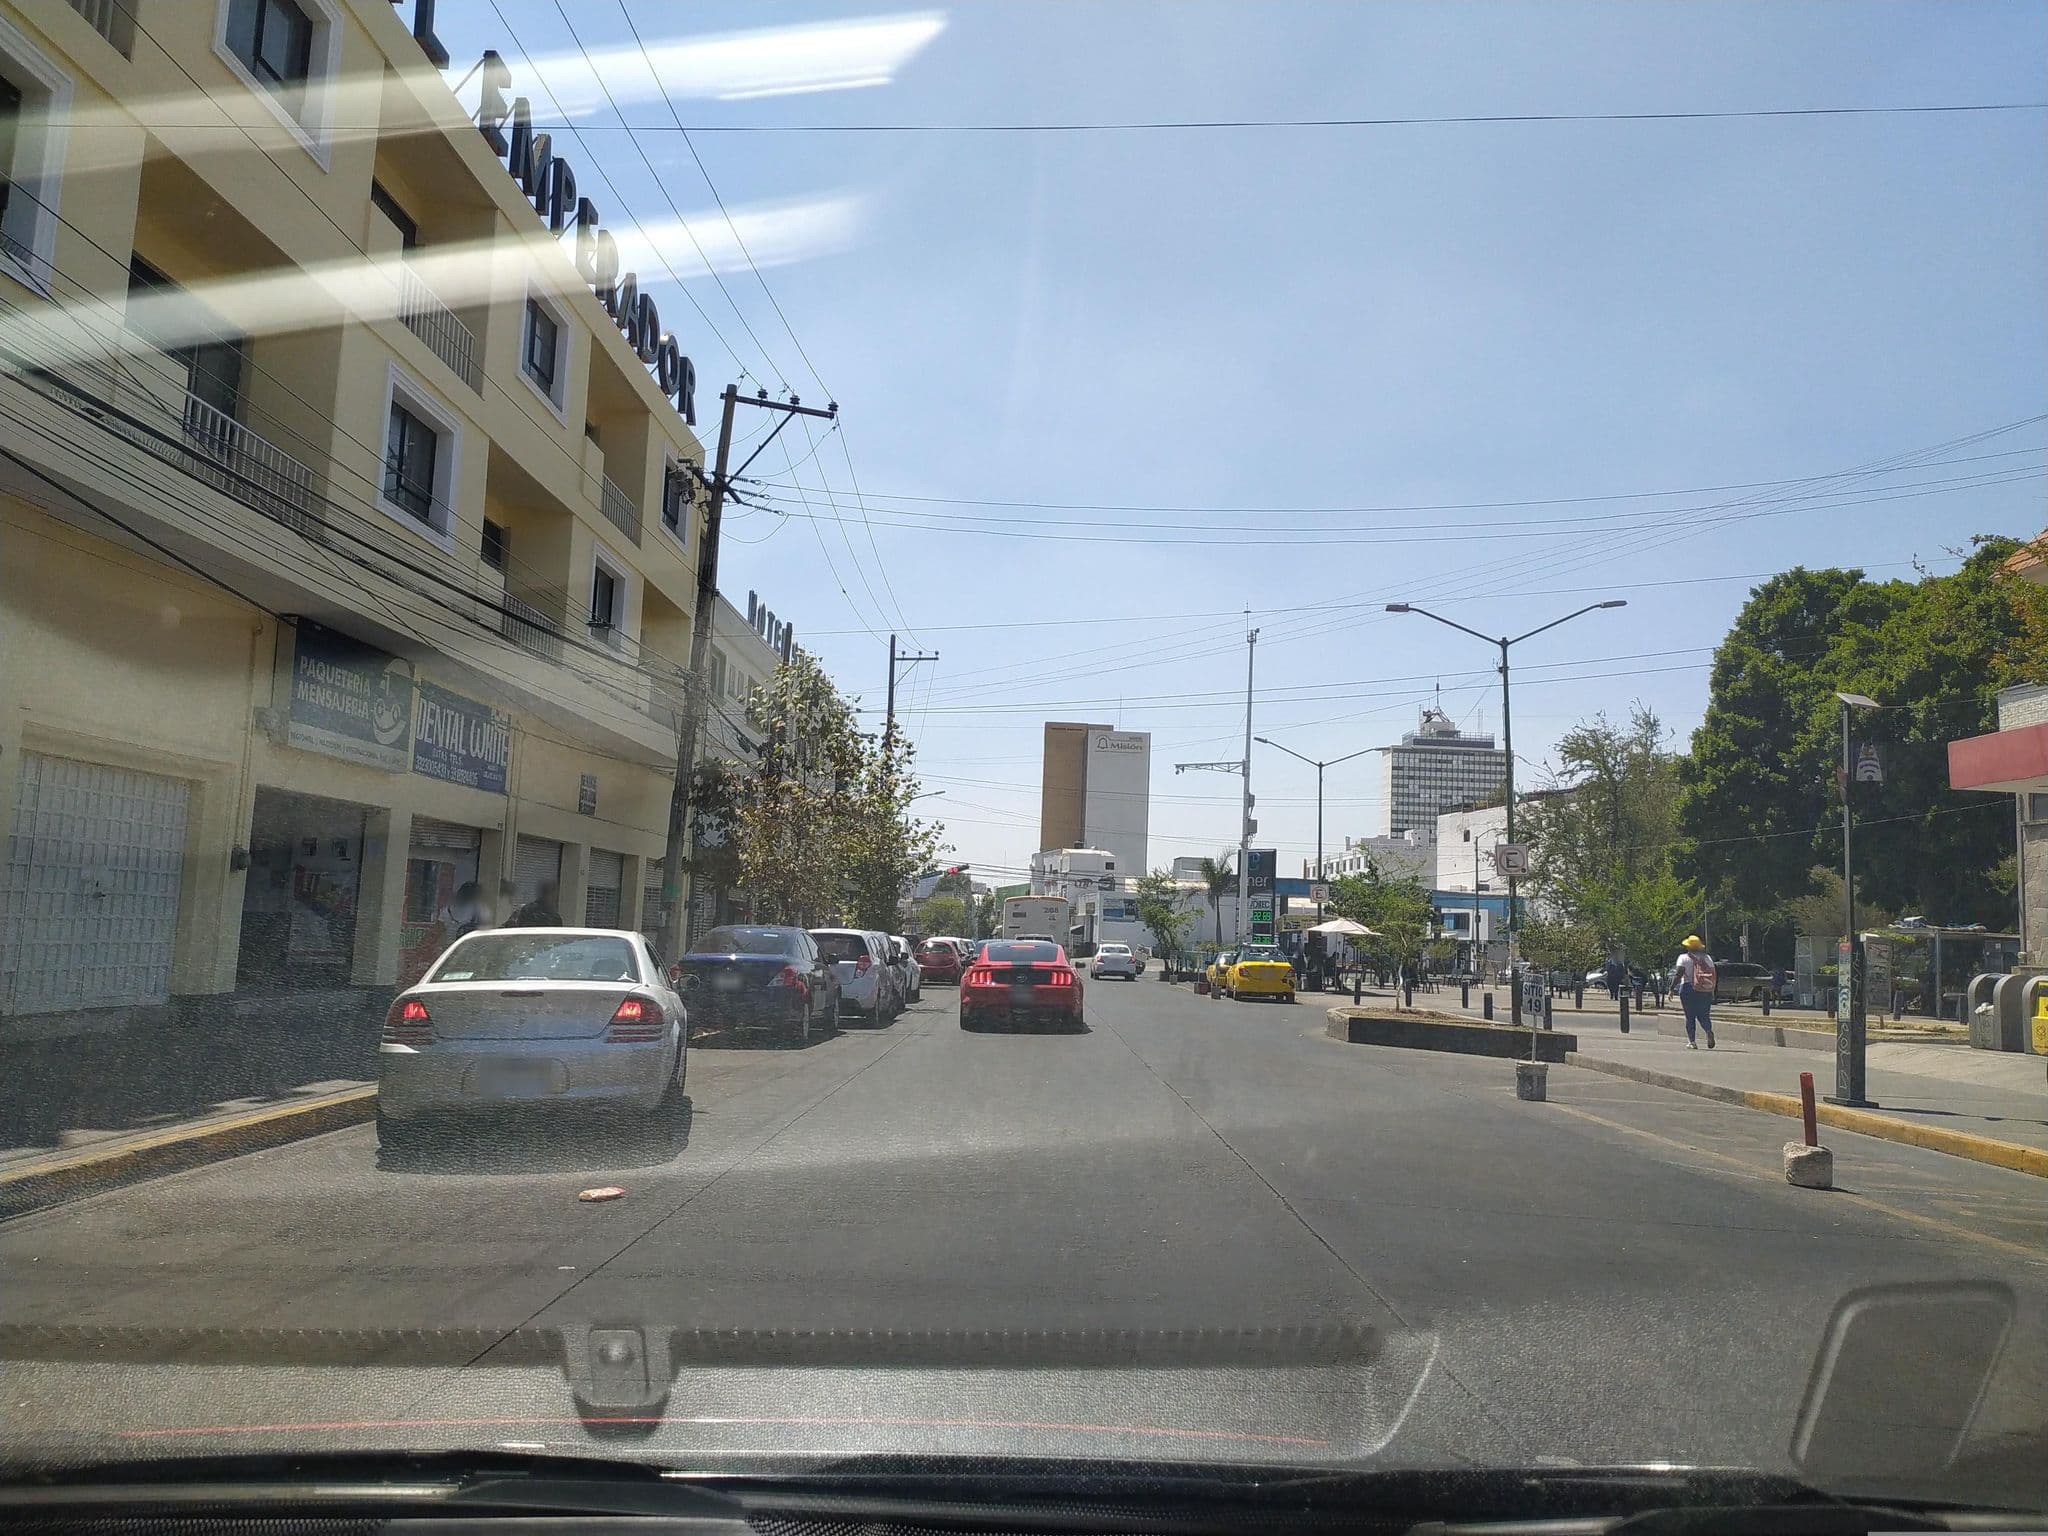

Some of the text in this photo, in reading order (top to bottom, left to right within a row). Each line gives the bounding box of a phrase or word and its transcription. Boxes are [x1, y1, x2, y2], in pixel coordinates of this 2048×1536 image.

[479, 50, 695, 426] EMPERADOR
[416, 697, 466, 755] DENTAL
[470, 719, 508, 767] WHITE
[1110, 741, 1143, 751] Misión
[1523, 982, 1543, 997] SITIO
[1527, 999, 1542, 1013] 19
